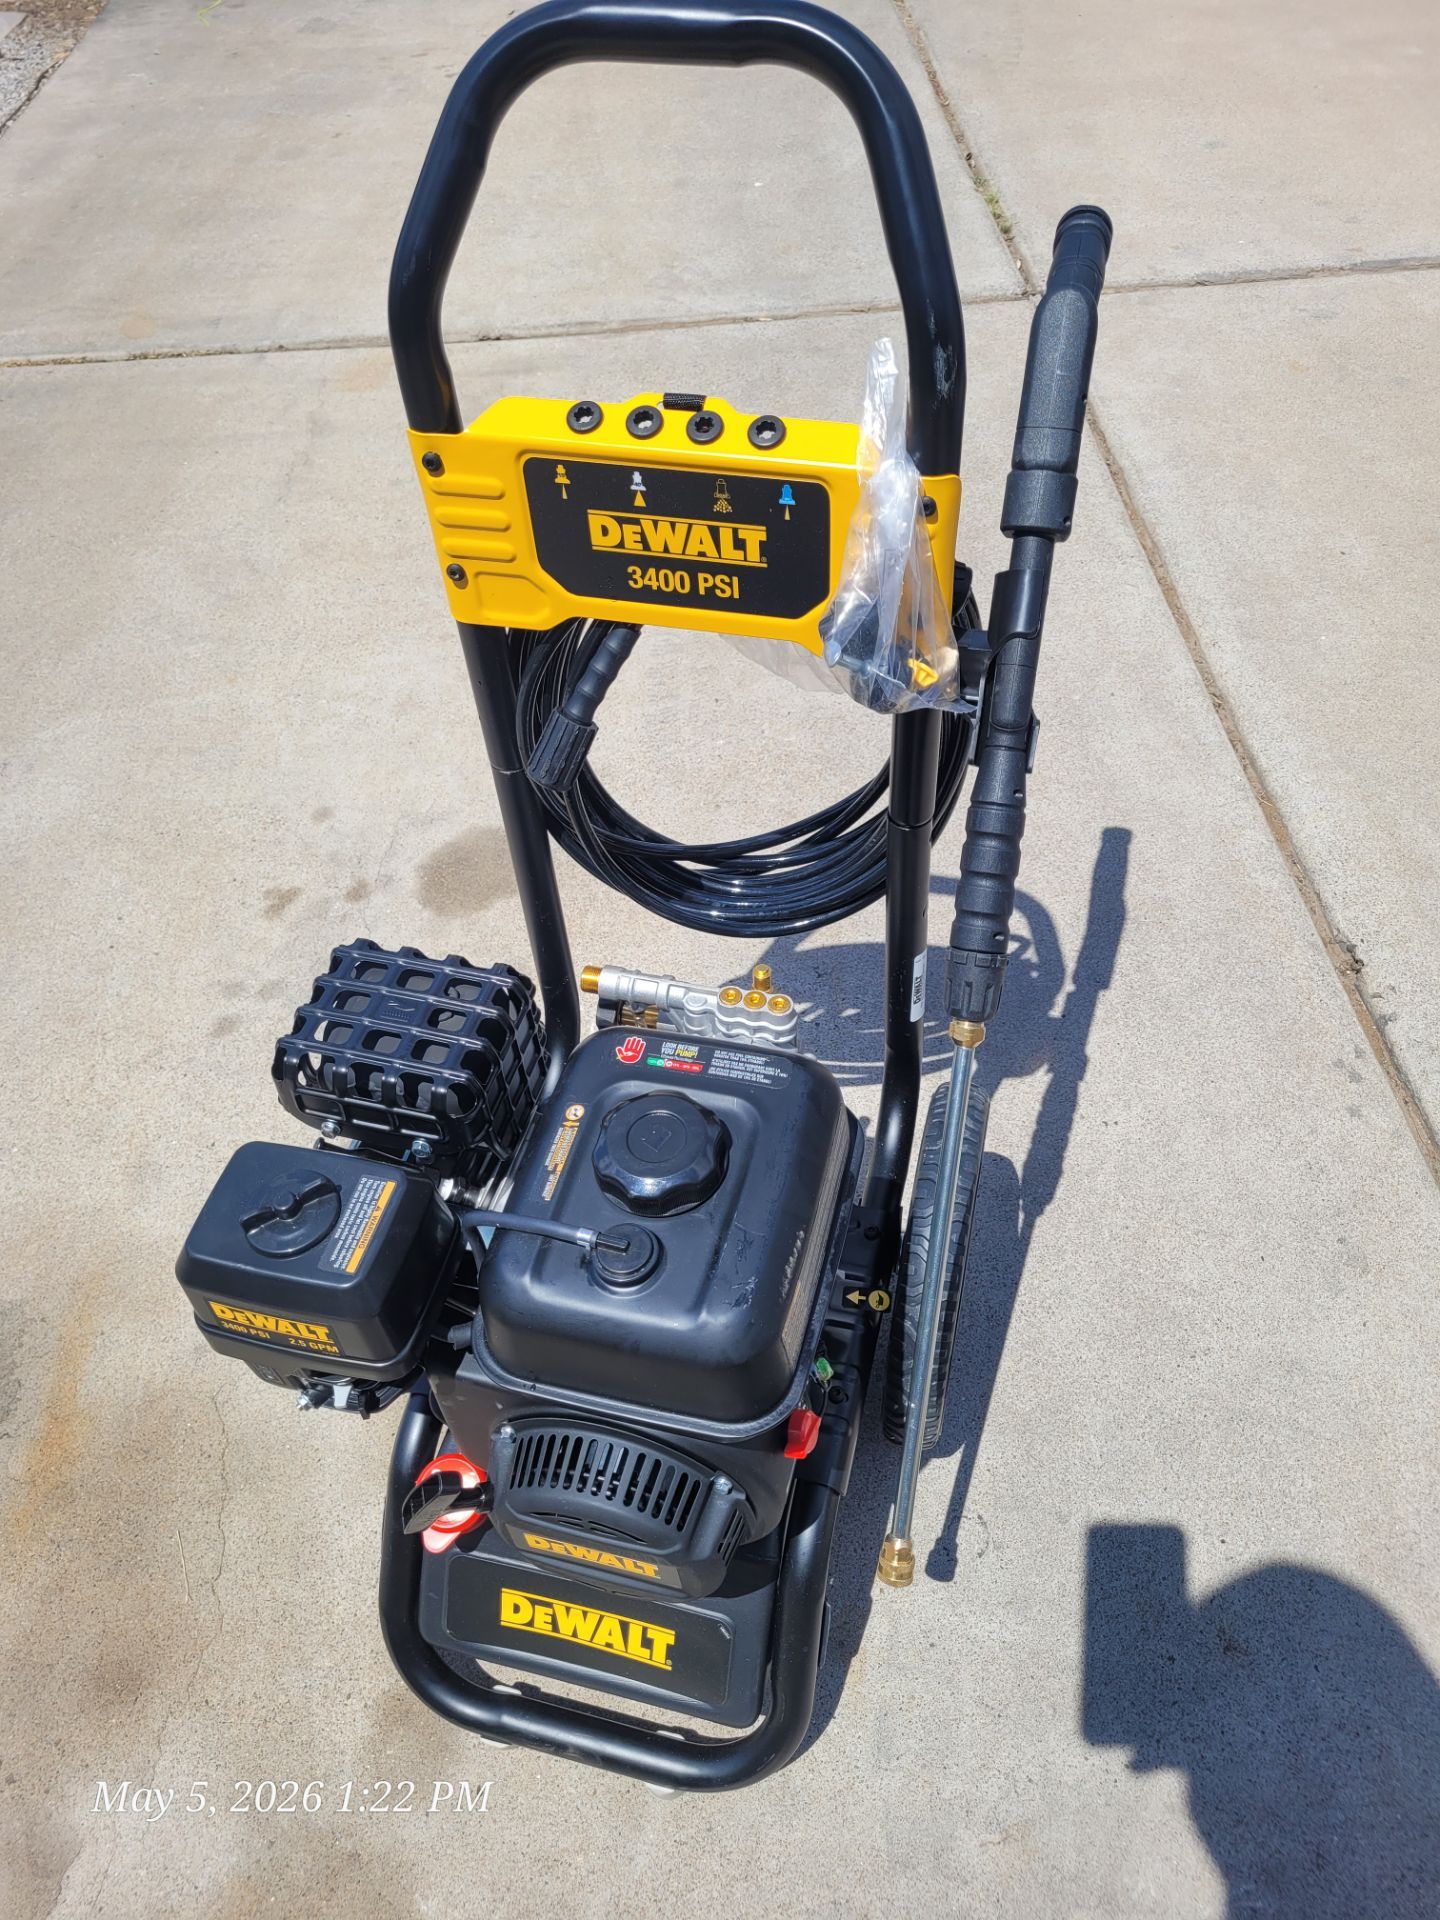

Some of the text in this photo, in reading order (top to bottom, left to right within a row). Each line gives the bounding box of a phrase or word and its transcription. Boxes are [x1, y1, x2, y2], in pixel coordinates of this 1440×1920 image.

[627, 565, 740, 599] 3400 PSI
[661, 1047, 698, 1058] YOU PUMP!
[662, 1042, 677, 1050] LOOK
[358, 1214, 379, 1249] WARNING
[209, 1302, 331, 1342] DEWALT
[221, 1321, 339, 1353] 3400 PSI 2.5 GPM
[527, 1535, 660, 1577] DEWALT
[501, 1592, 675, 1665] DEWALT
